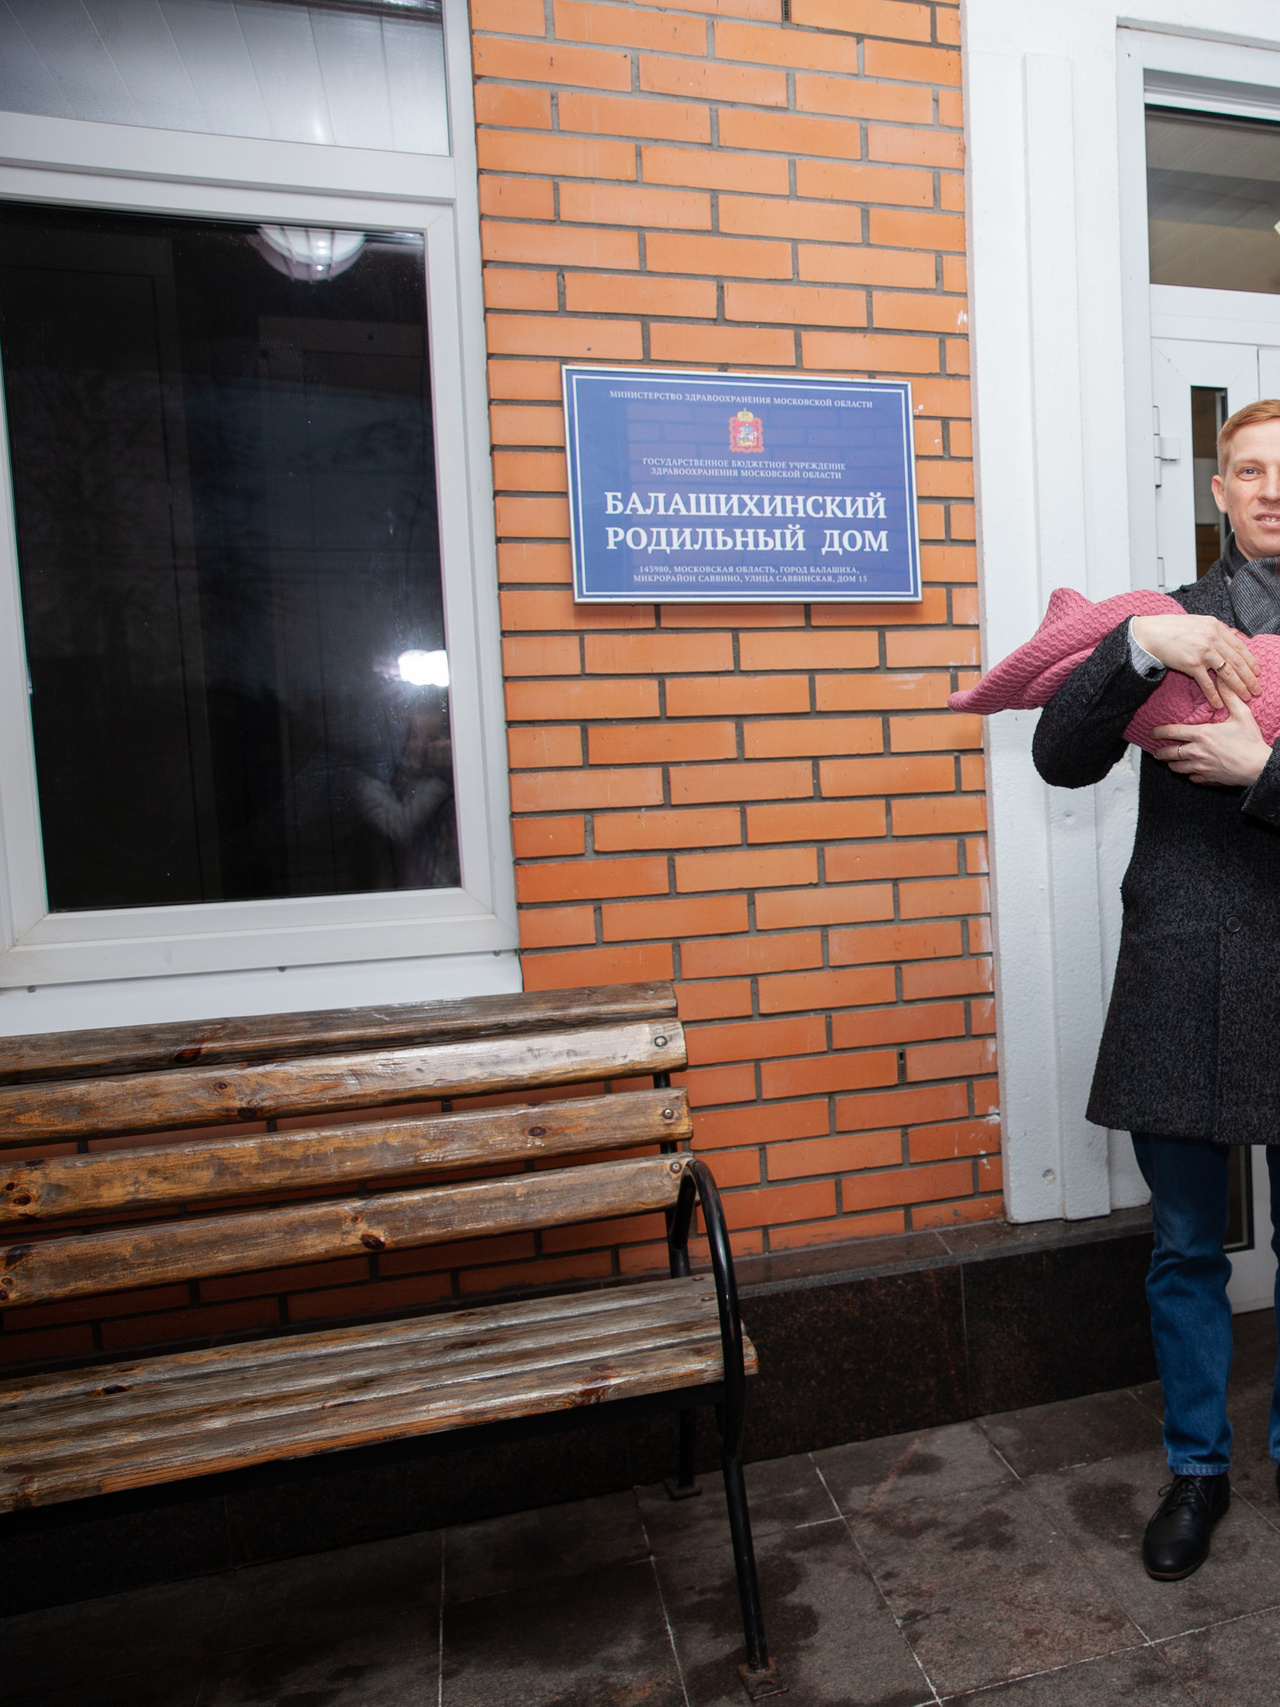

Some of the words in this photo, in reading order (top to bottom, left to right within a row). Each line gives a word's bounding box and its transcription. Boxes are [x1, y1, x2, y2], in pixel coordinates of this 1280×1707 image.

[609, 390, 683, 401] МИНИСТЕРСТВО
[685, 393, 771, 404] ЗДРАВООХРАНЕНИЯ
[773, 396, 832, 407] МОСКОВСКОЙ
[834, 399, 873, 408] ОБЛАСТИ
[643, 457, 730, 468] ГОСУДАРСТВЕННОЕ
[731, 459, 787, 470] БЮДЖЕТНОЕ
[788, 461, 846, 471] УЧРЕЖДЕНИЕ
[651, 467, 738, 478] ЗДРАВООХРАНЕНИЯ
[740, 468, 800, 479] МОСКОВСКОЙ
[802, 470, 842, 480] ОБЛАСТИ
[603, 491, 888, 519] БАЛАШИХИНСКИЙ
[605, 524, 807, 555] РОДИЛЬНЫЙ
[821, 529, 890, 556] ДОМ
[673, 565, 734, 574] МОСКОВСКАЯ
[735, 565, 778, 575] ОБЛАСТЬ,
[780, 566, 808, 575] ГОРОД
[809, 566, 860, 575] БАЛАШИХА,
[633, 573, 696, 583] МИКРОРАЙОН
[698, 574, 743, 584] САВВИНО,
[744, 574, 774, 583] УЛИЦА
[836, 574, 858, 584] ДОМ
[858, 574, 868, 583] 15
